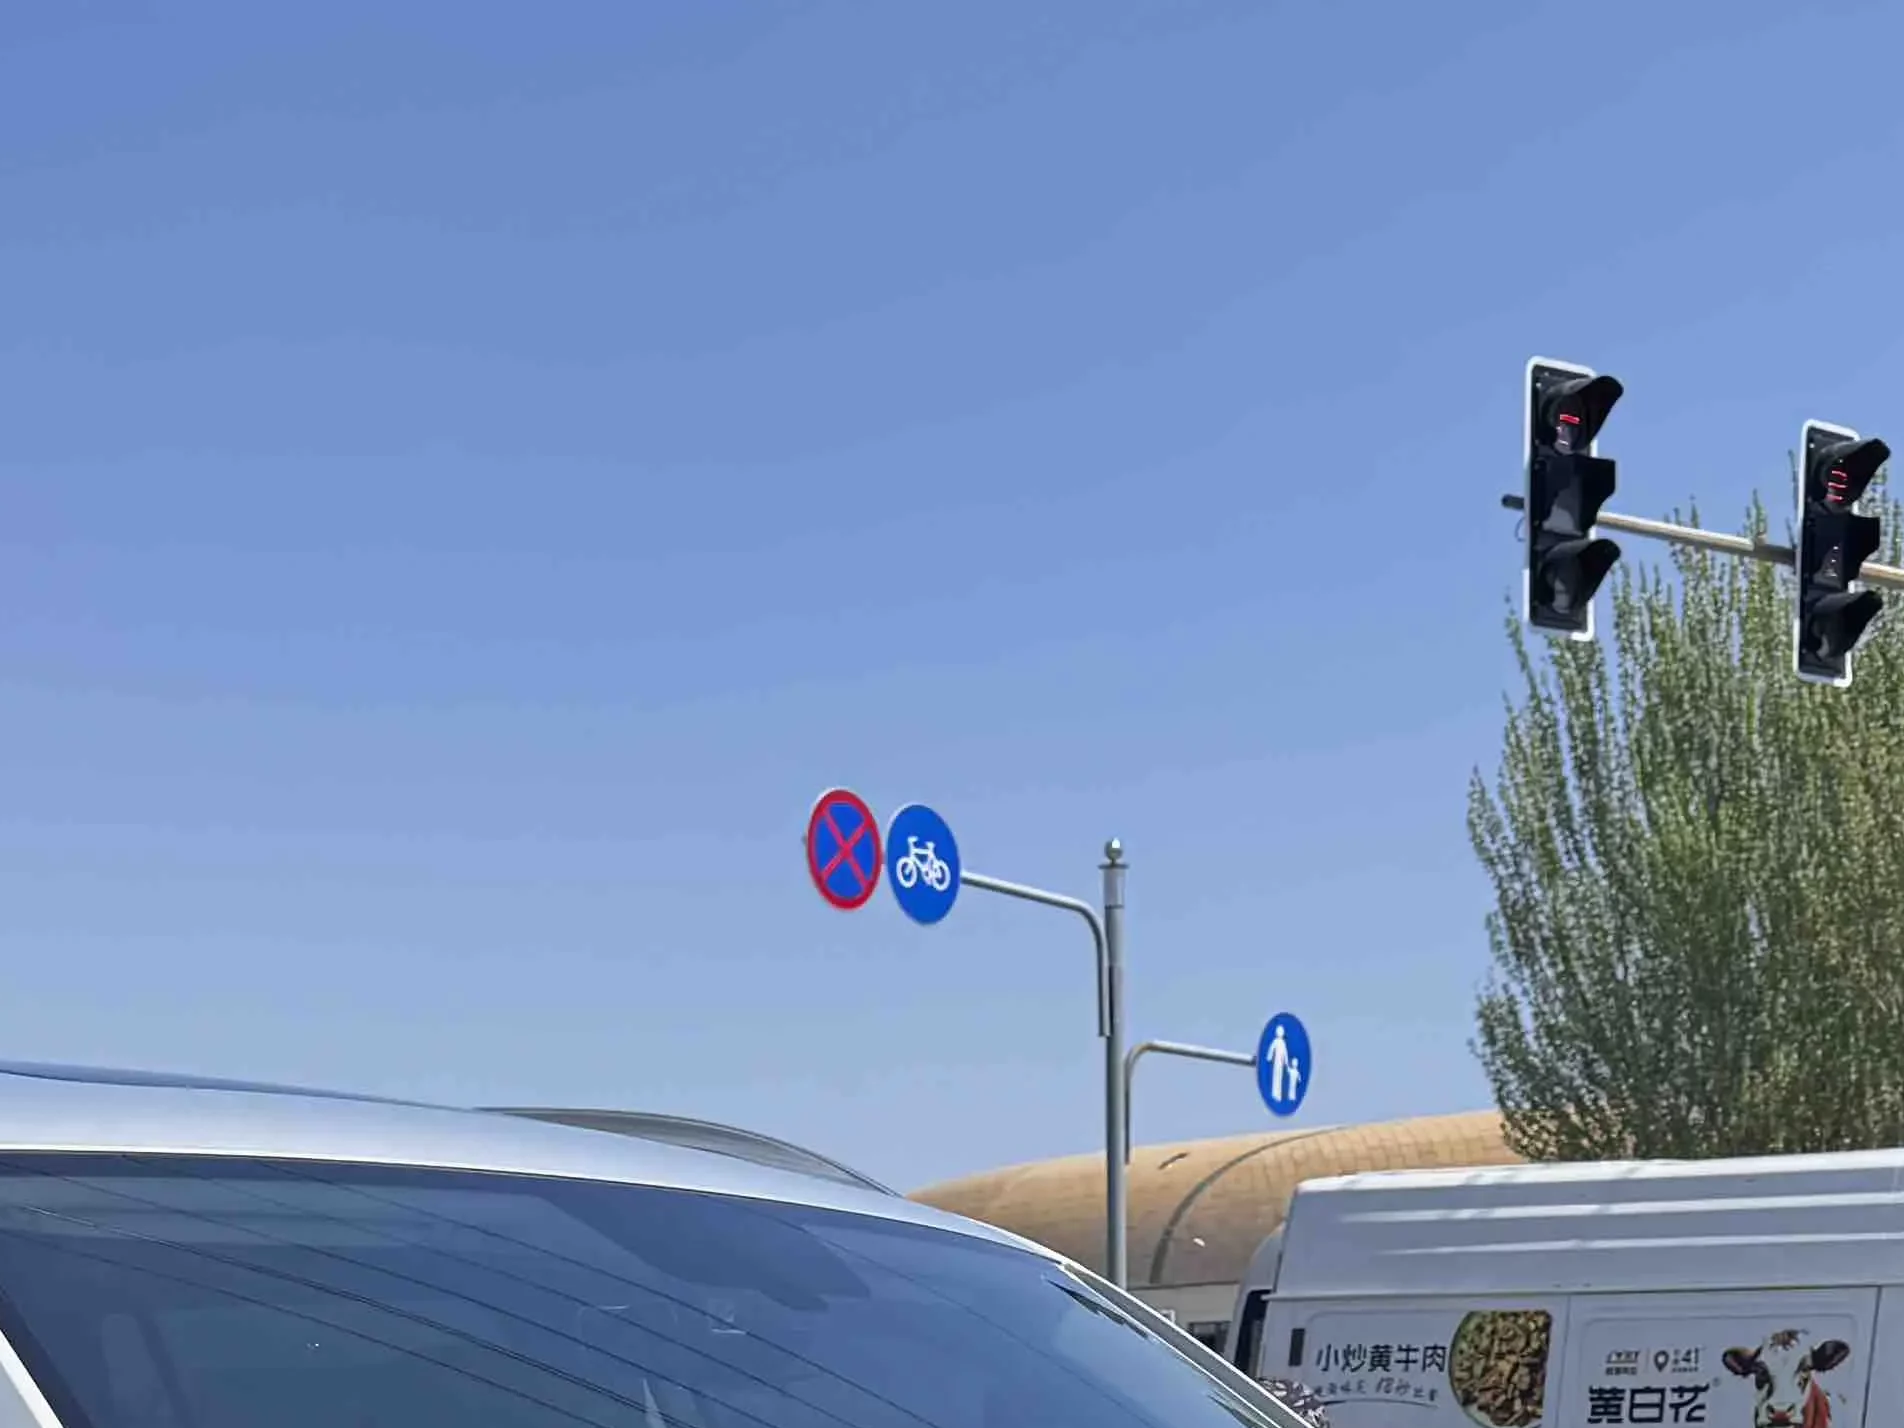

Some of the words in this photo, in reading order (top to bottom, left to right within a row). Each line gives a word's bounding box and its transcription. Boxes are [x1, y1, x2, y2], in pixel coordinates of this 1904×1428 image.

[1315, 1343, 1449, 1373] 小炒黄牛肉
